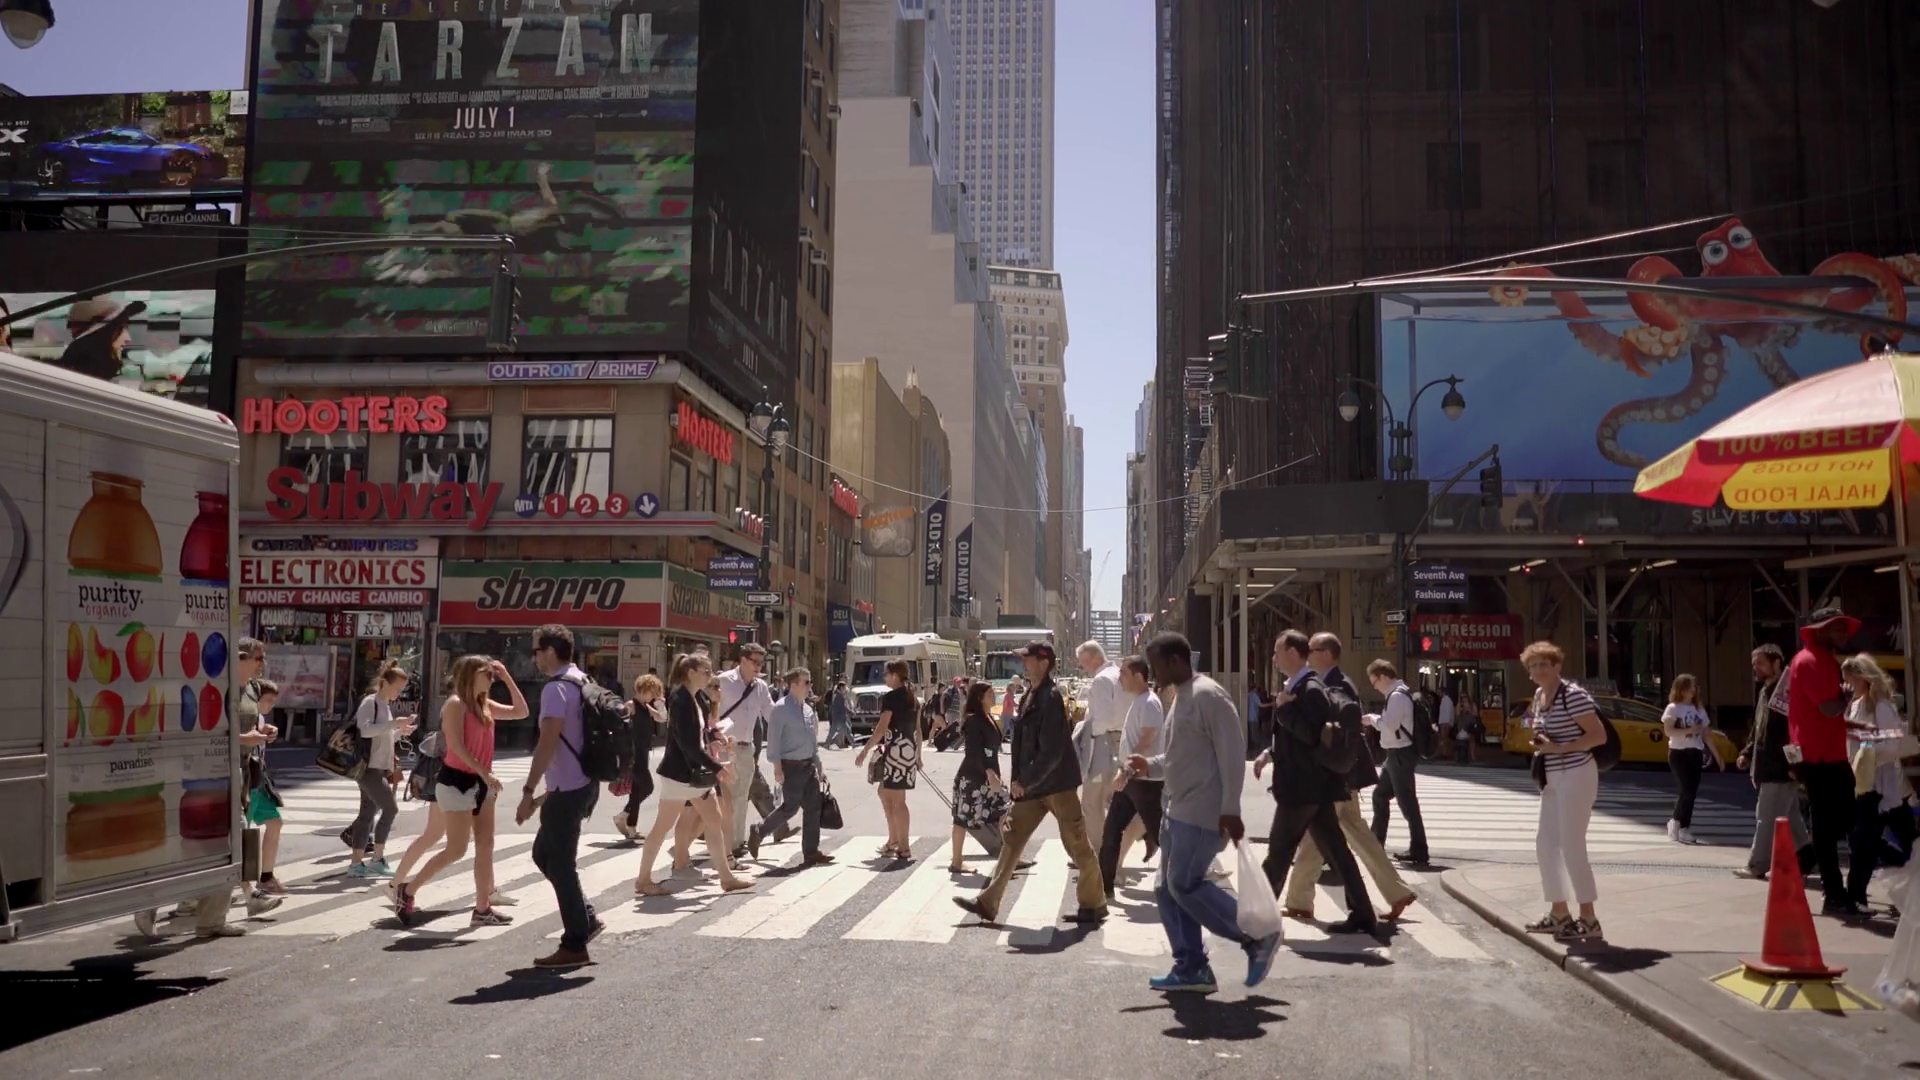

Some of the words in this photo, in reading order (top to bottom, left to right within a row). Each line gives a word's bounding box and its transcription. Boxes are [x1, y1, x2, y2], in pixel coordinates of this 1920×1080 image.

[332, 3, 388, 17] THE
[454, 106, 499, 129] JULY
[508, 106, 515, 127] 1
[479, 130, 491, 138] 3D
[507, 130, 535, 138] IMAX
[537, 129, 552, 137] 3D
[490, 362, 587, 379] OUTFRONT
[597, 360, 650, 378] PRIME
[242, 395, 448, 435] HOOTERS
[678, 401, 734, 466] HOOTERS
[1718, 433, 1795, 457] 100%
[1799, 424, 1886, 450] BEEF
[265, 465, 505, 531] Subway
[514, 498, 535, 514] MTA
[550, 498, 560, 513] 1
[580, 497, 593, 514] 2
[610, 497, 623, 514] 3
[928, 512, 943, 540] OLD
[957, 541, 970, 565] OLD
[239, 558, 427, 586] ELECTRONICS
[709, 560, 739, 570] Seventh
[739, 560, 755, 570] Ave
[709, 578, 738, 588] Fashion
[738, 578, 753, 588] Ave
[957, 568, 970, 601] NAVY
[1413, 570, 1447, 580] Seventh
[1449, 571, 1465, 580] Ave
[245, 590, 297, 604] MONEY
[301, 590, 361, 604] CHANGE
[367, 589, 424, 604] CAMBIO
[476, 567, 627, 612] sbarro
[670, 575, 711, 621] sbarro
[1414, 590, 1447, 600] Fashion
[1448, 590, 1465, 600] Ave
[184, 590, 229, 614] purit
[718, 595, 730, 618] the
[261, 609, 295, 626] CHANGE
[393, 610, 423, 629] MONEY
[833, 609, 849, 620] DELI
[362, 624, 387, 636] NY
[1419, 624, 1512, 637] IMPRESSION
[1455, 641, 1497, 650] FASHION
